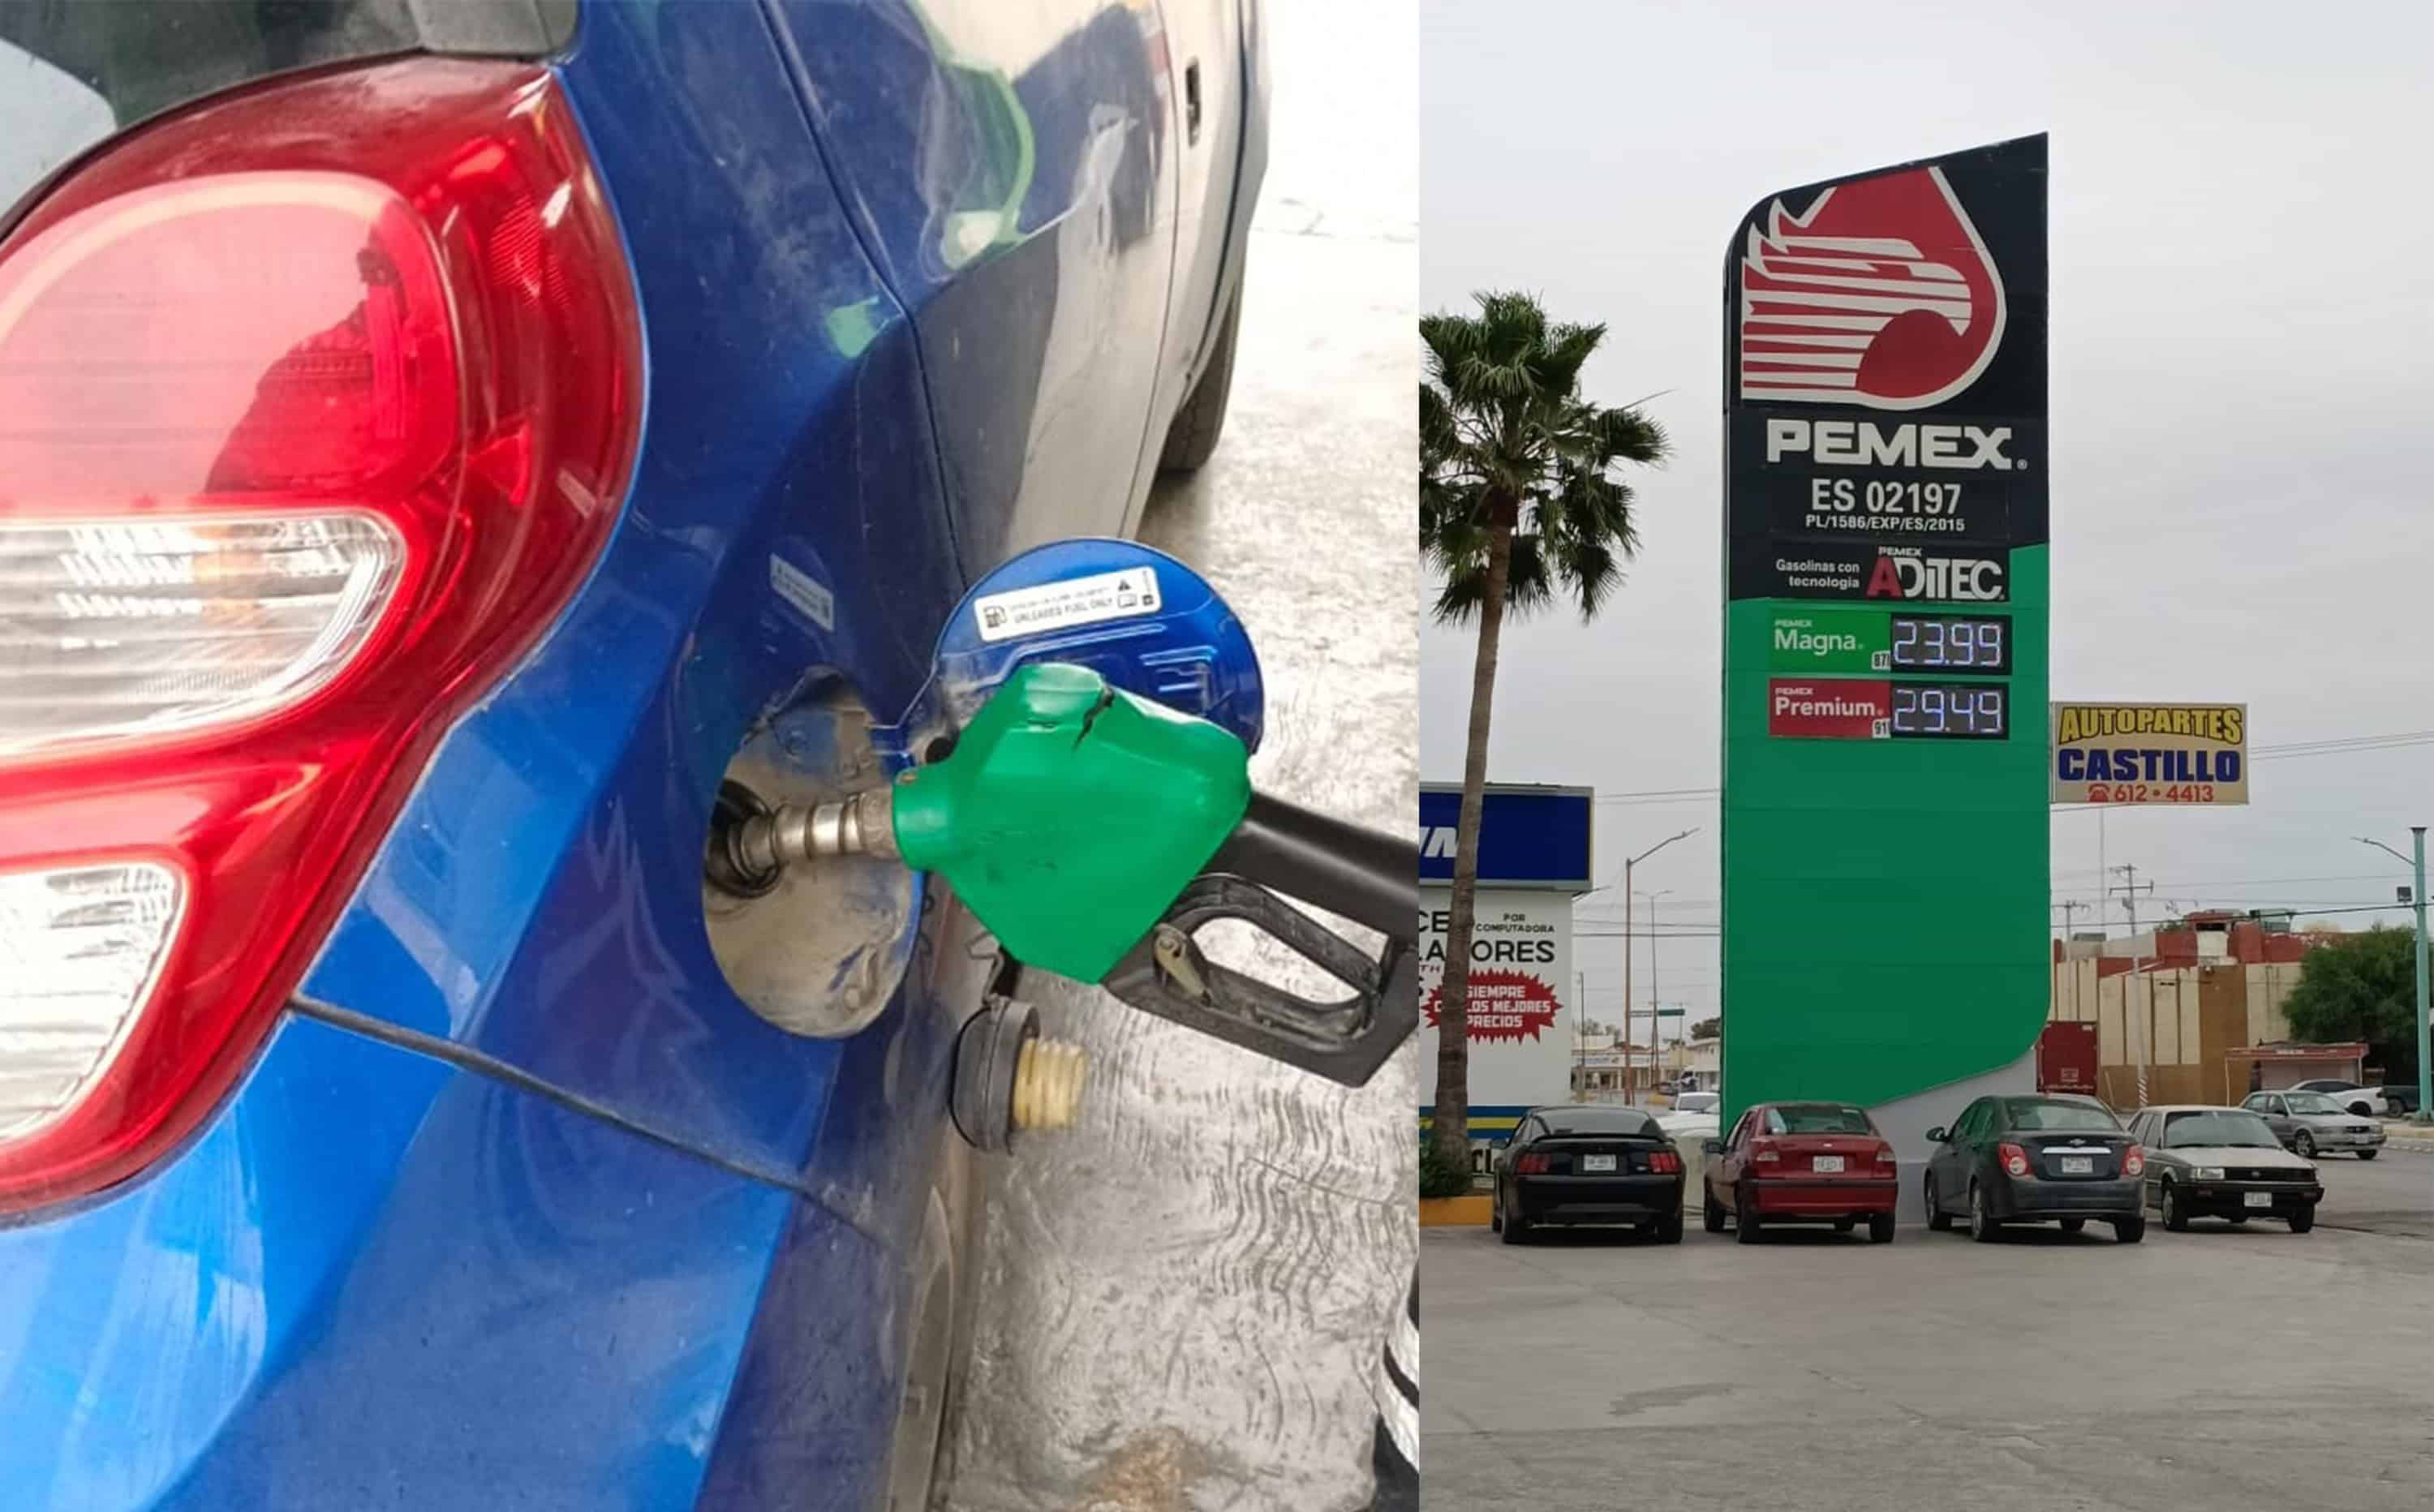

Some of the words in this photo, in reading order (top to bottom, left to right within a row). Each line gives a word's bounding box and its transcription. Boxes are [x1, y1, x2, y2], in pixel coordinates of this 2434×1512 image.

[1766, 419, 2013, 470] PEMEX
[1812, 479, 1856, 512] ES
[1866, 481, 1962, 515] 02197
[1805, 514, 1965, 532] PL/1586/EXP/ES/2015
[1877, 546, 1923, 557] PEMEX
[1775, 559, 1835, 572] Gasolinas
[1838, 563, 1860, 573] con
[1774, 629, 1857, 656] Magna
[1894, 621, 2002, 666] 23.99
[1774, 697, 1876, 716] Premium
[1894, 689, 2002, 733] 29.49
[2058, 707, 2243, 745] AUTOPARTES
[2058, 748, 2241, 783] CASTILLO
[1503, 913, 1525, 921] POR
[1475, 923, 1555, 933] COMPUTADORA
[1467, 986, 1526, 999] SIEMPRE
[1492, 1001, 1551, 1013] MEJORES
